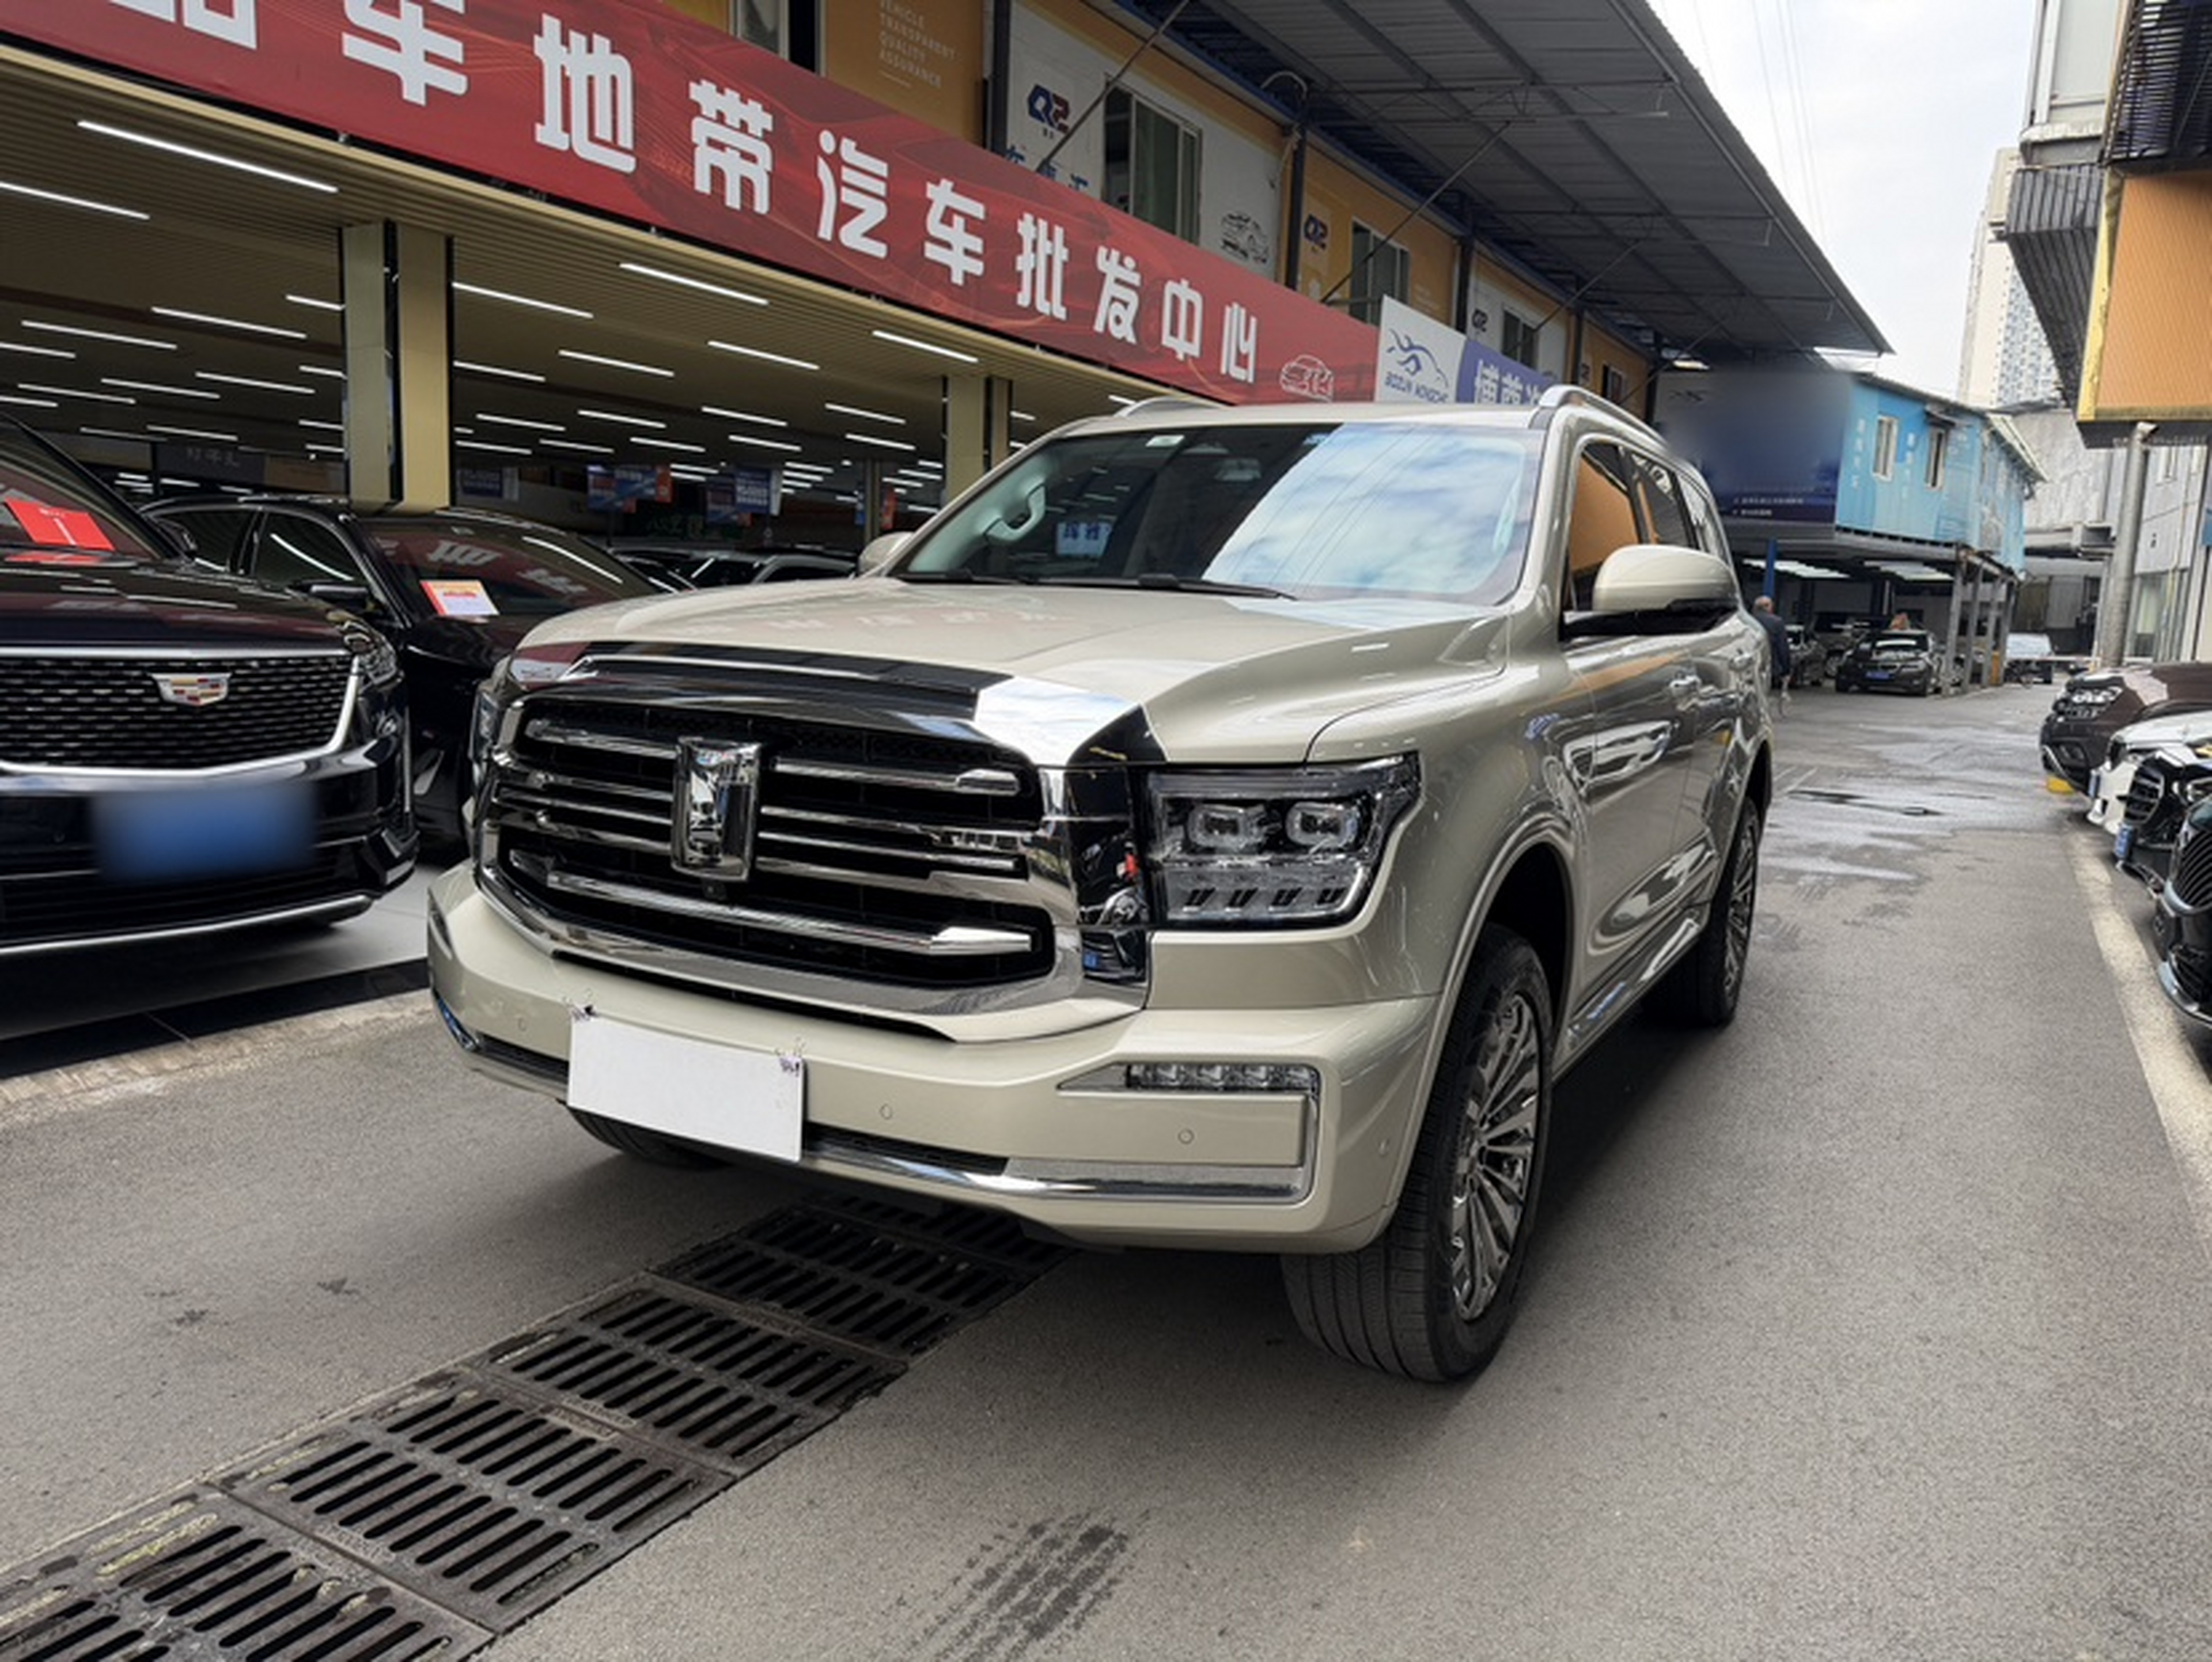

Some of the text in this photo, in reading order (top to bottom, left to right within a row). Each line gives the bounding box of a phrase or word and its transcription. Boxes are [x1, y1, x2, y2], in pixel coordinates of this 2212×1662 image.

[109, 0, 1257, 384] 车地带汽车批发中心
